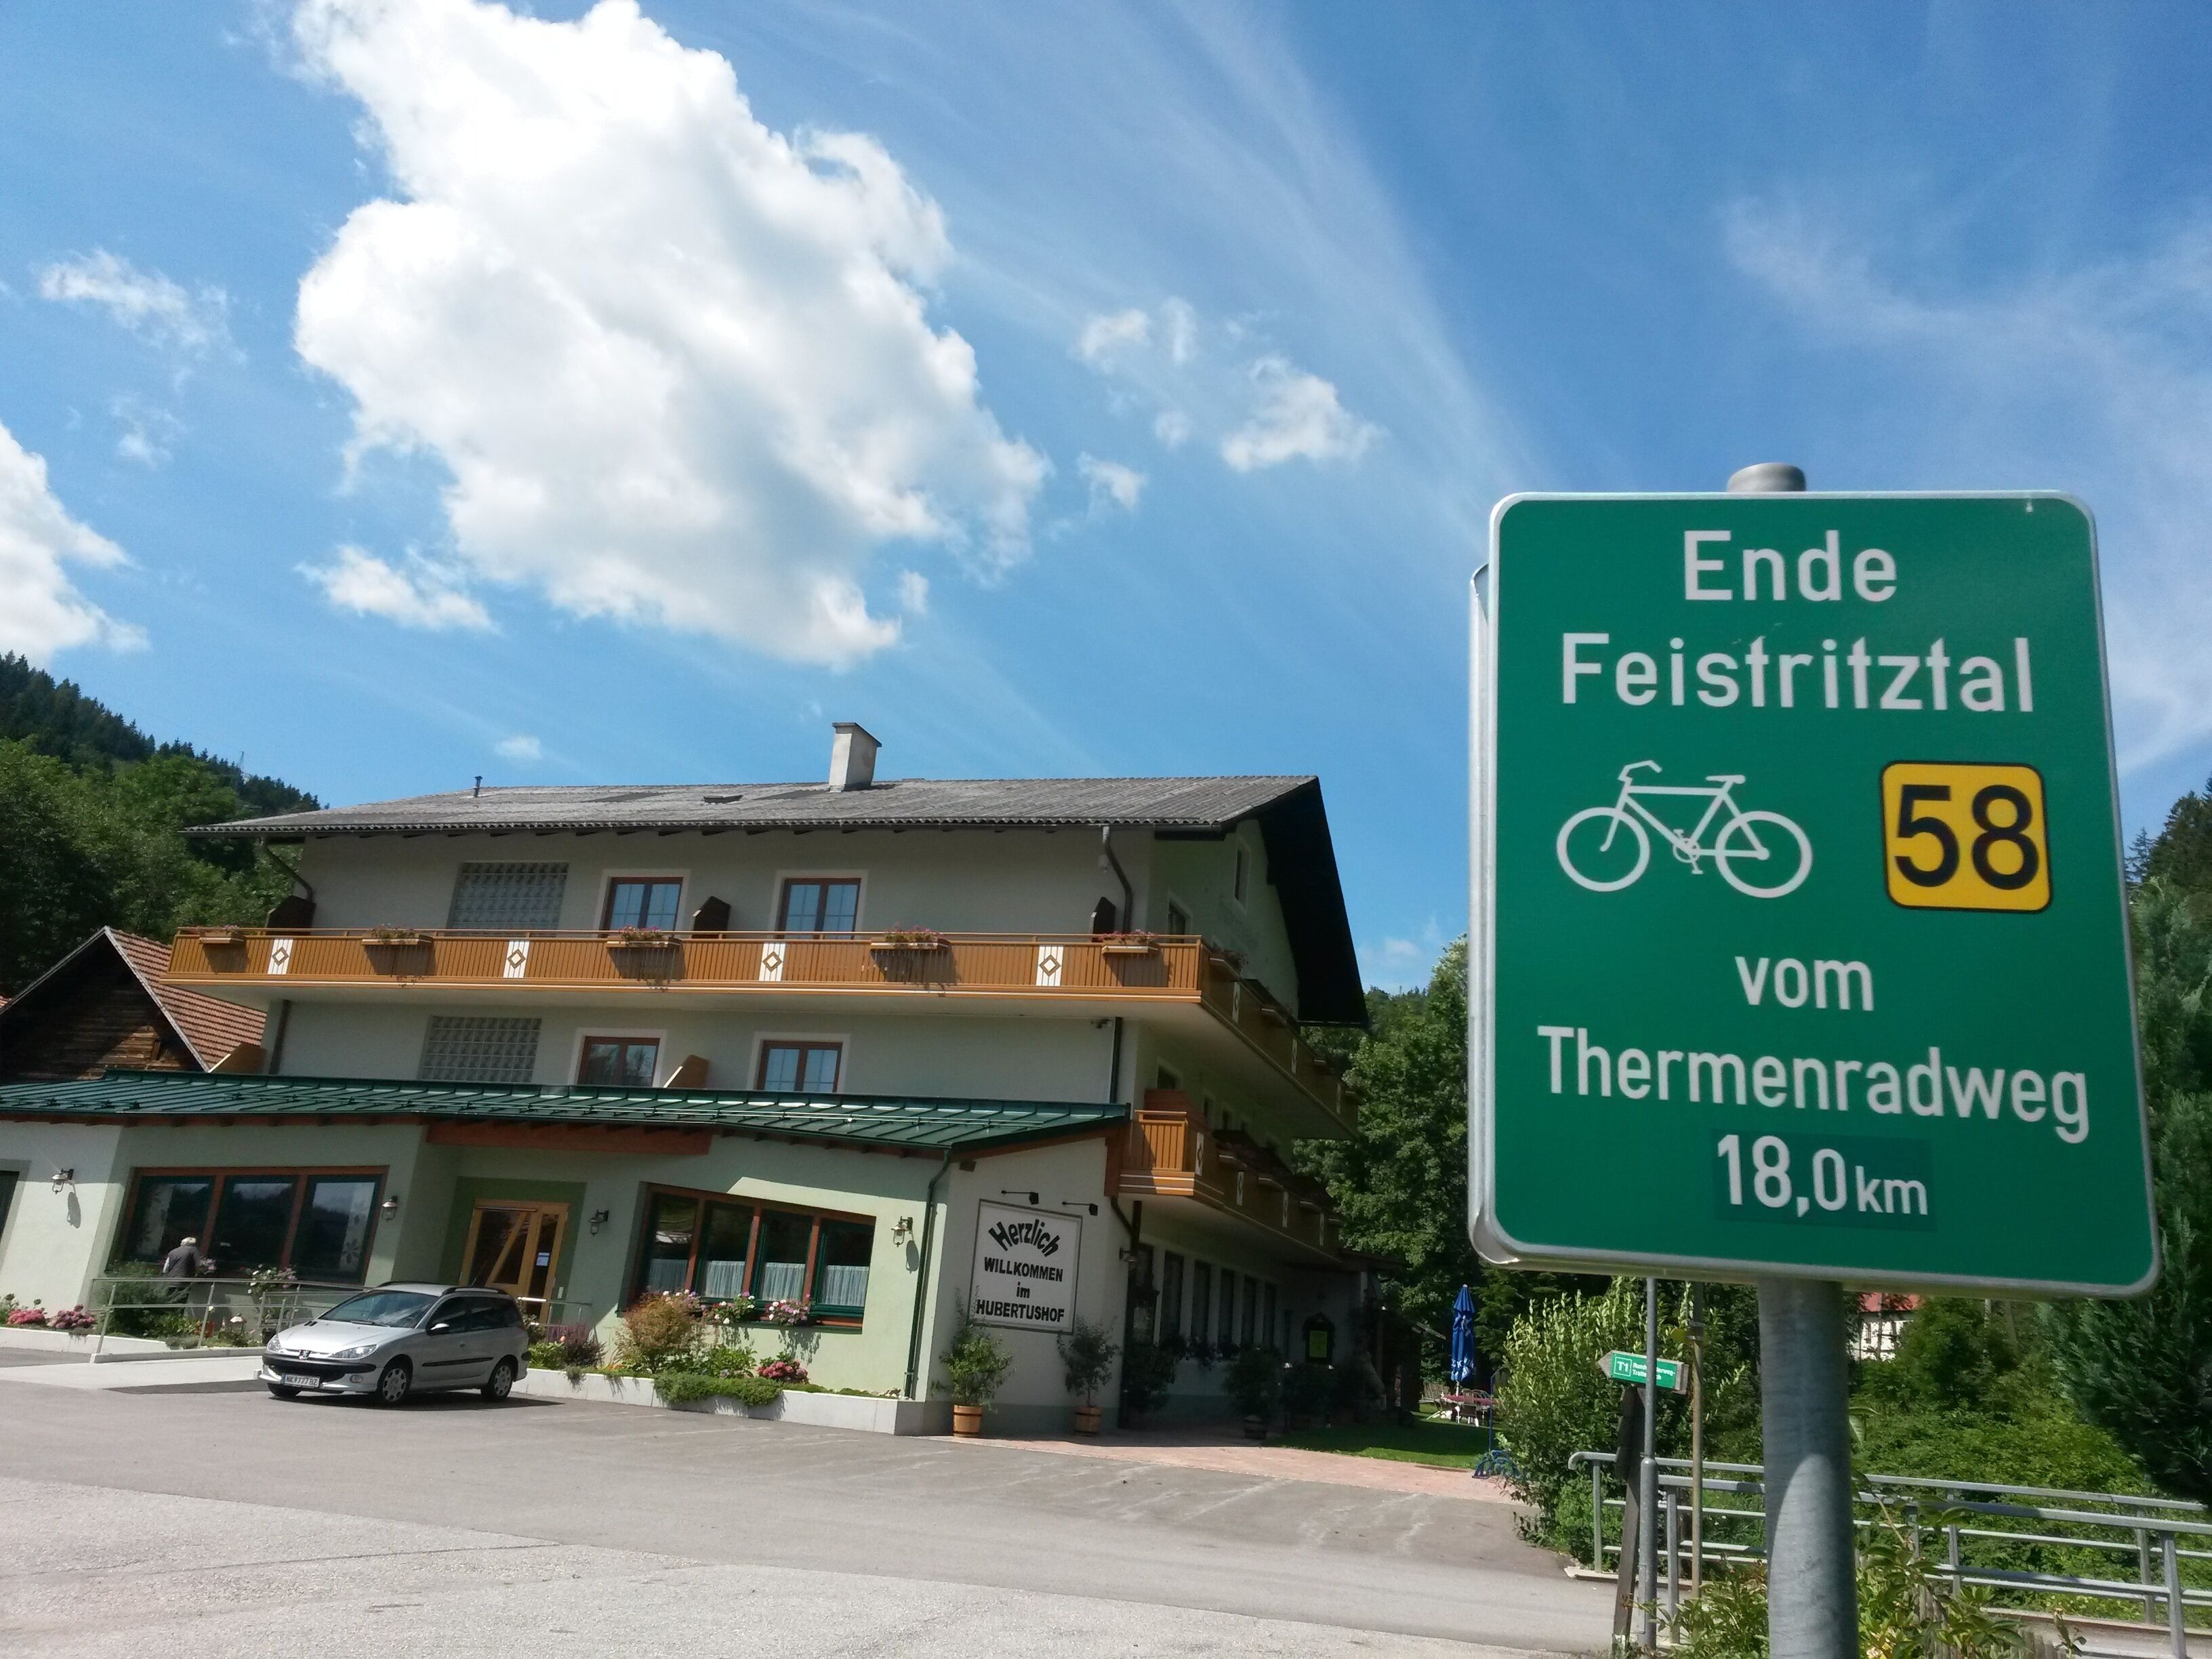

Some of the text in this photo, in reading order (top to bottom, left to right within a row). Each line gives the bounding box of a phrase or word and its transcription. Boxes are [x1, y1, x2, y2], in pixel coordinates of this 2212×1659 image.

[1684, 530, 1897, 602] Ende
[1562, 633, 2032, 713] Feistritztal
[1894, 783, 2040, 891] 58
[1735, 956, 1873, 1010] vom
[1538, 1025, 2089, 1144] Thermenradweg
[1717, 1134, 1928, 1216] 18,0 km
[988, 1219, 1060, 1257] Herzlich
[984, 1256, 1063, 1282] WILLKOMMEN
[1016, 1282, 1030, 1298] im
[976, 1299, 1065, 1322] HUBERTUSHOF
[1617, 1360, 1629, 1372] T1
